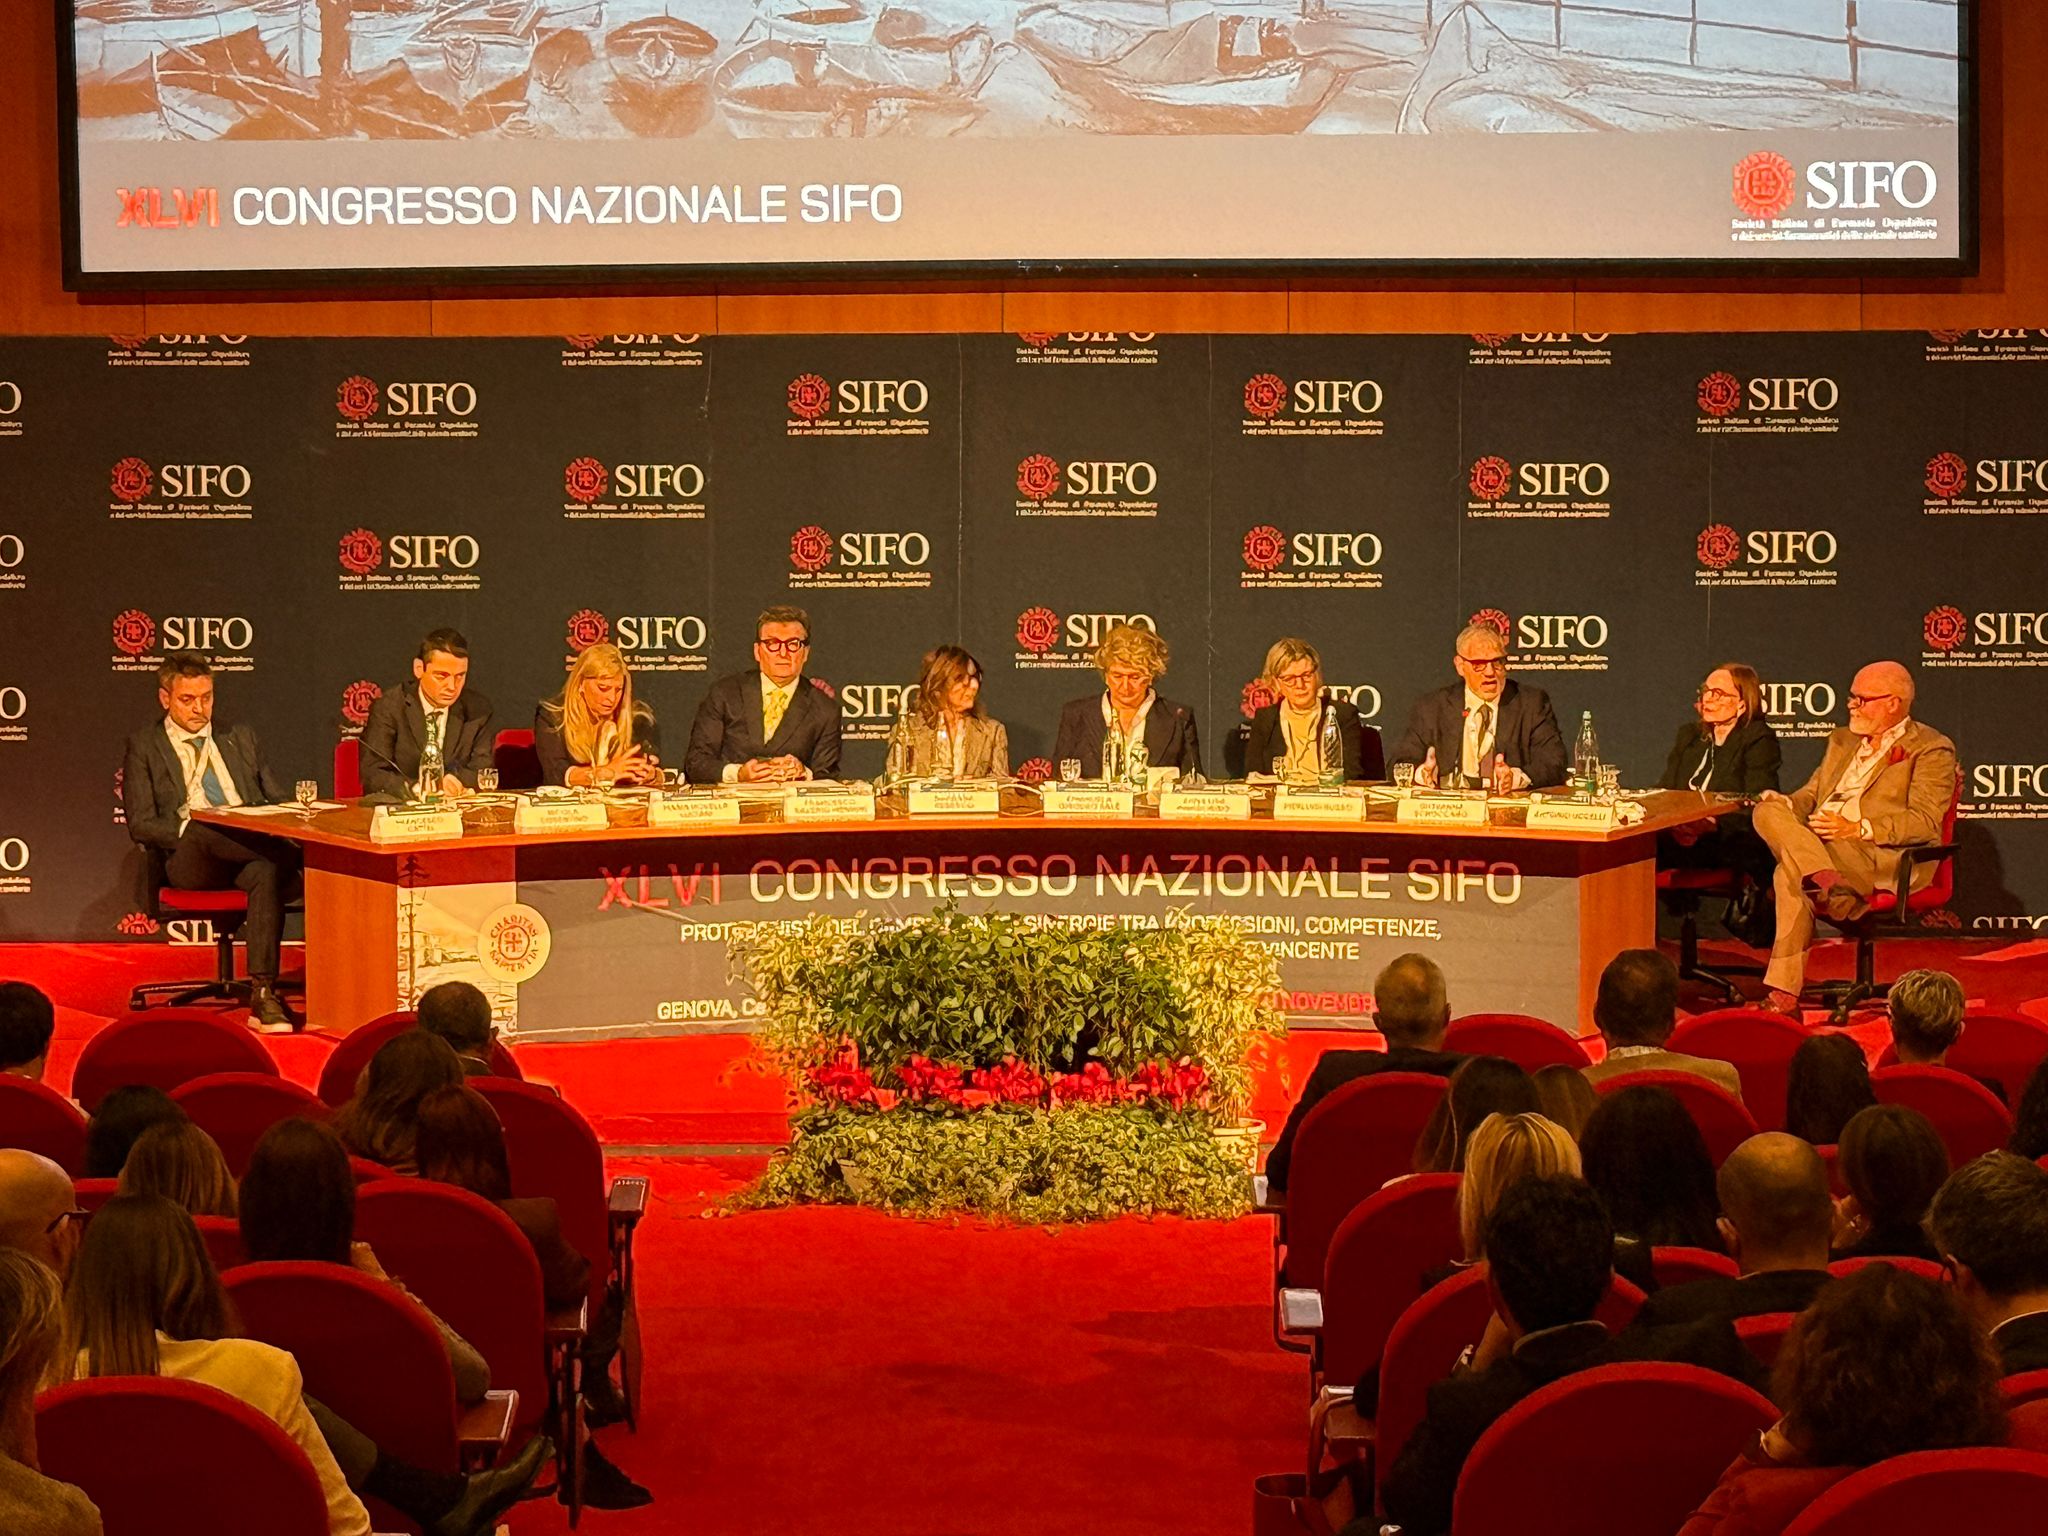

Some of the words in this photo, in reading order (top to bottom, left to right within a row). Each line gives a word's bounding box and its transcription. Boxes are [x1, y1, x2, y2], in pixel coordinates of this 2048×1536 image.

[1806, 160, 1938, 210] SIFO
[115, 187, 220, 229] XLVI
[233, 186, 517, 226] CONGRESSO
[531, 184, 787, 224] NAZIONALE
[800, 183, 902, 222] SIFO
[388, 382, 477, 416] SIFO
[838, 379, 929, 414] SIFO
[1293, 380, 1383, 414] SIFO
[1748, 377, 1839, 411] SIFO
[161, 464, 251, 498] SIFO
[615, 463, 705, 497] SIFO
[1066, 461, 1157, 495] SIFO
[1519, 462, 1610, 496] SIFO
[389, 535, 480, 569] SIFO
[839, 532, 930, 567] SIFO
[1292, 532, 1383, 567] SIFO
[1746, 530, 1837, 564] SIFO
[163, 616, 253, 650] SIFO
[616, 616, 707, 650] SIFO
[1517, 615, 1608, 649] SIFO
[598, 862, 721, 912] XLVI
[750, 854, 1078, 903] CONGRESSO
[1096, 854, 1391, 899] NAZIONALE
[1407, 858, 1522, 905] SIFO
[1305, 916, 1442, 940] COMPETENZE,
